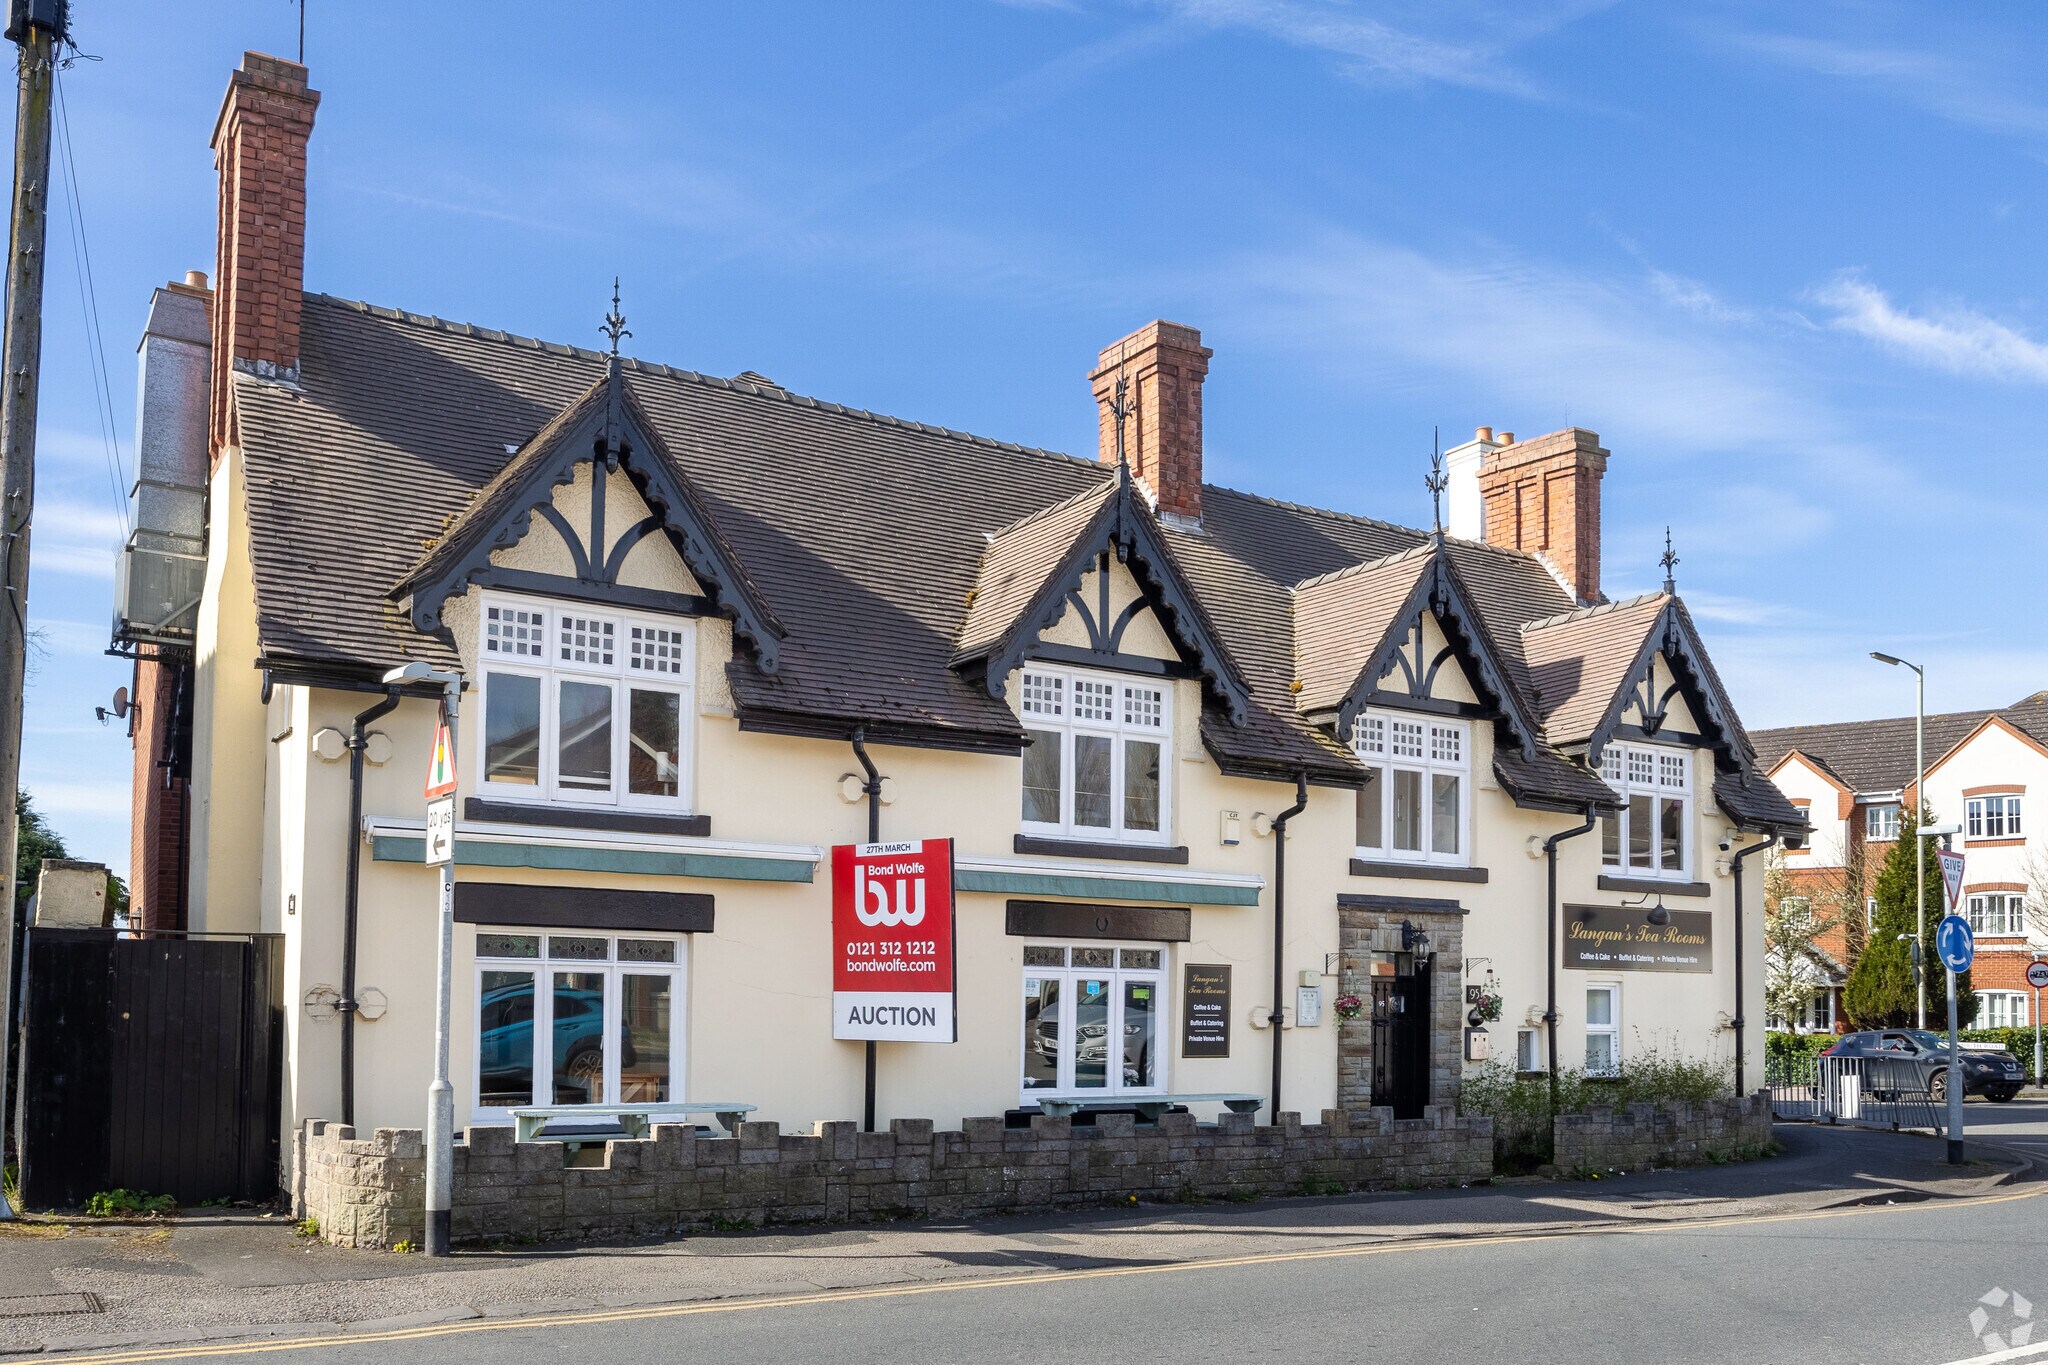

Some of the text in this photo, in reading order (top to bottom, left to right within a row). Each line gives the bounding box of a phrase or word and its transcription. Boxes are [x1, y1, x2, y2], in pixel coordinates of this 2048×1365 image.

[429, 809, 451, 828] 20 yds
[885, 844, 911, 852] MARCH
[868, 863, 925, 876] Bond Wolfe
[1944, 858, 1961, 872] GIVE
[855, 865, 925, 926] bw
[1569, 921, 1707, 947] Langan's Tea Rooms
[847, 941, 935, 955] 0121 312 1212
[1637, 954, 1654, 963] Catering
[847, 959, 935, 972] bondwolfe.com
[1192, 974, 1224, 985] Langan's
[1203, 986, 1226, 994] Rooms
[1470, 988, 1479, 1000] 95
[848, 1007, 935, 1026] AUCTION
